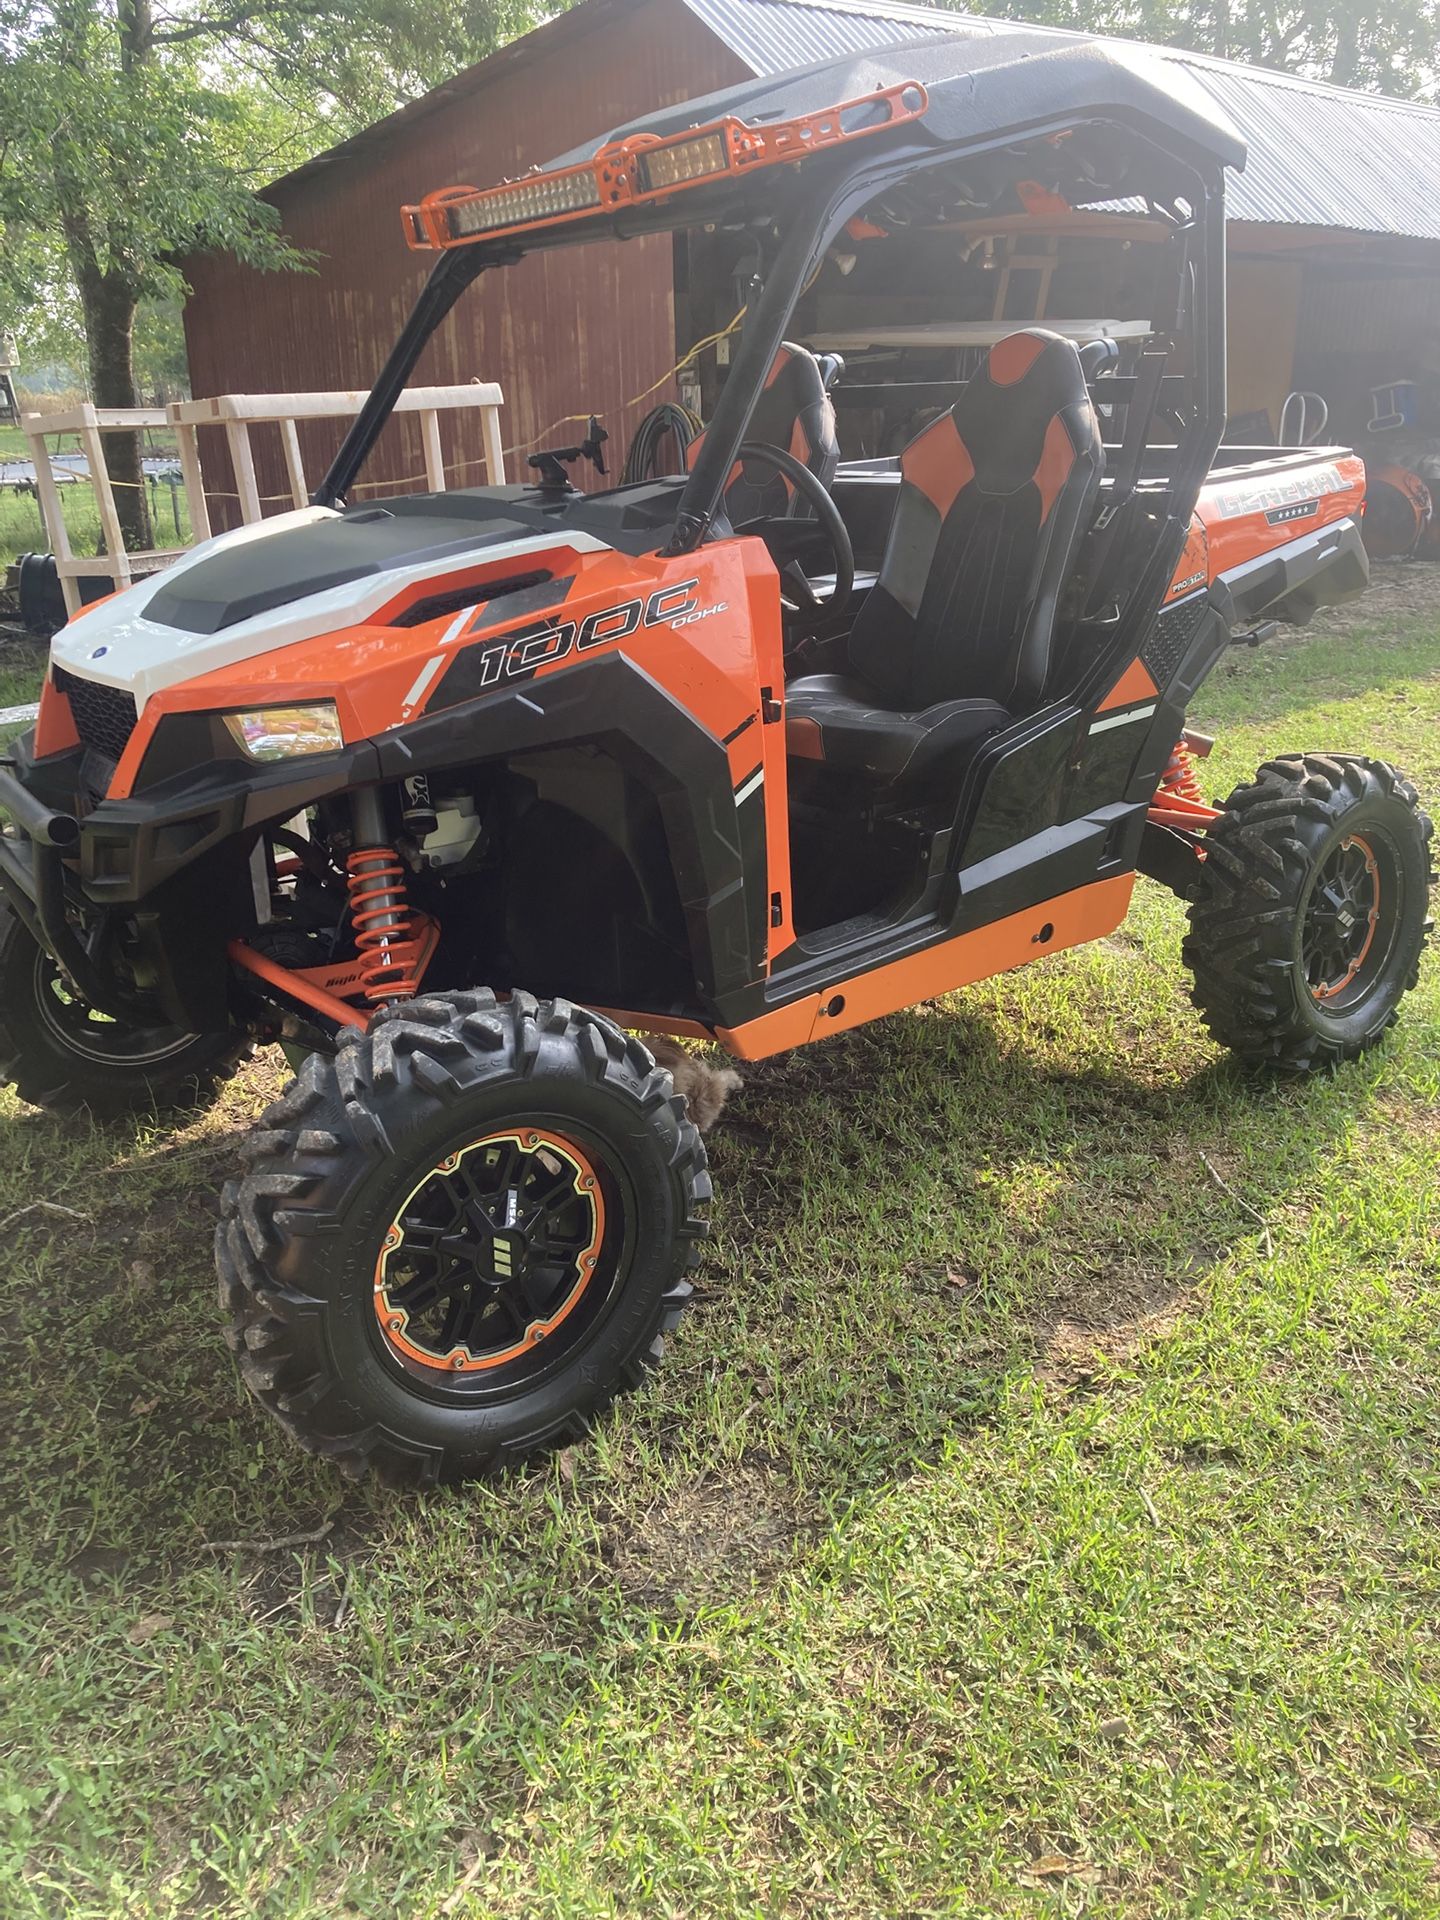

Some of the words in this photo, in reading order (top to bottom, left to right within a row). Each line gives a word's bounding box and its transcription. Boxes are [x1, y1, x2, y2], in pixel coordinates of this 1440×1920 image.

[1215, 469, 1354, 519] GENERAL
[671, 601, 728, 630] DOHC
[507, 1198, 517, 1227] MSA
